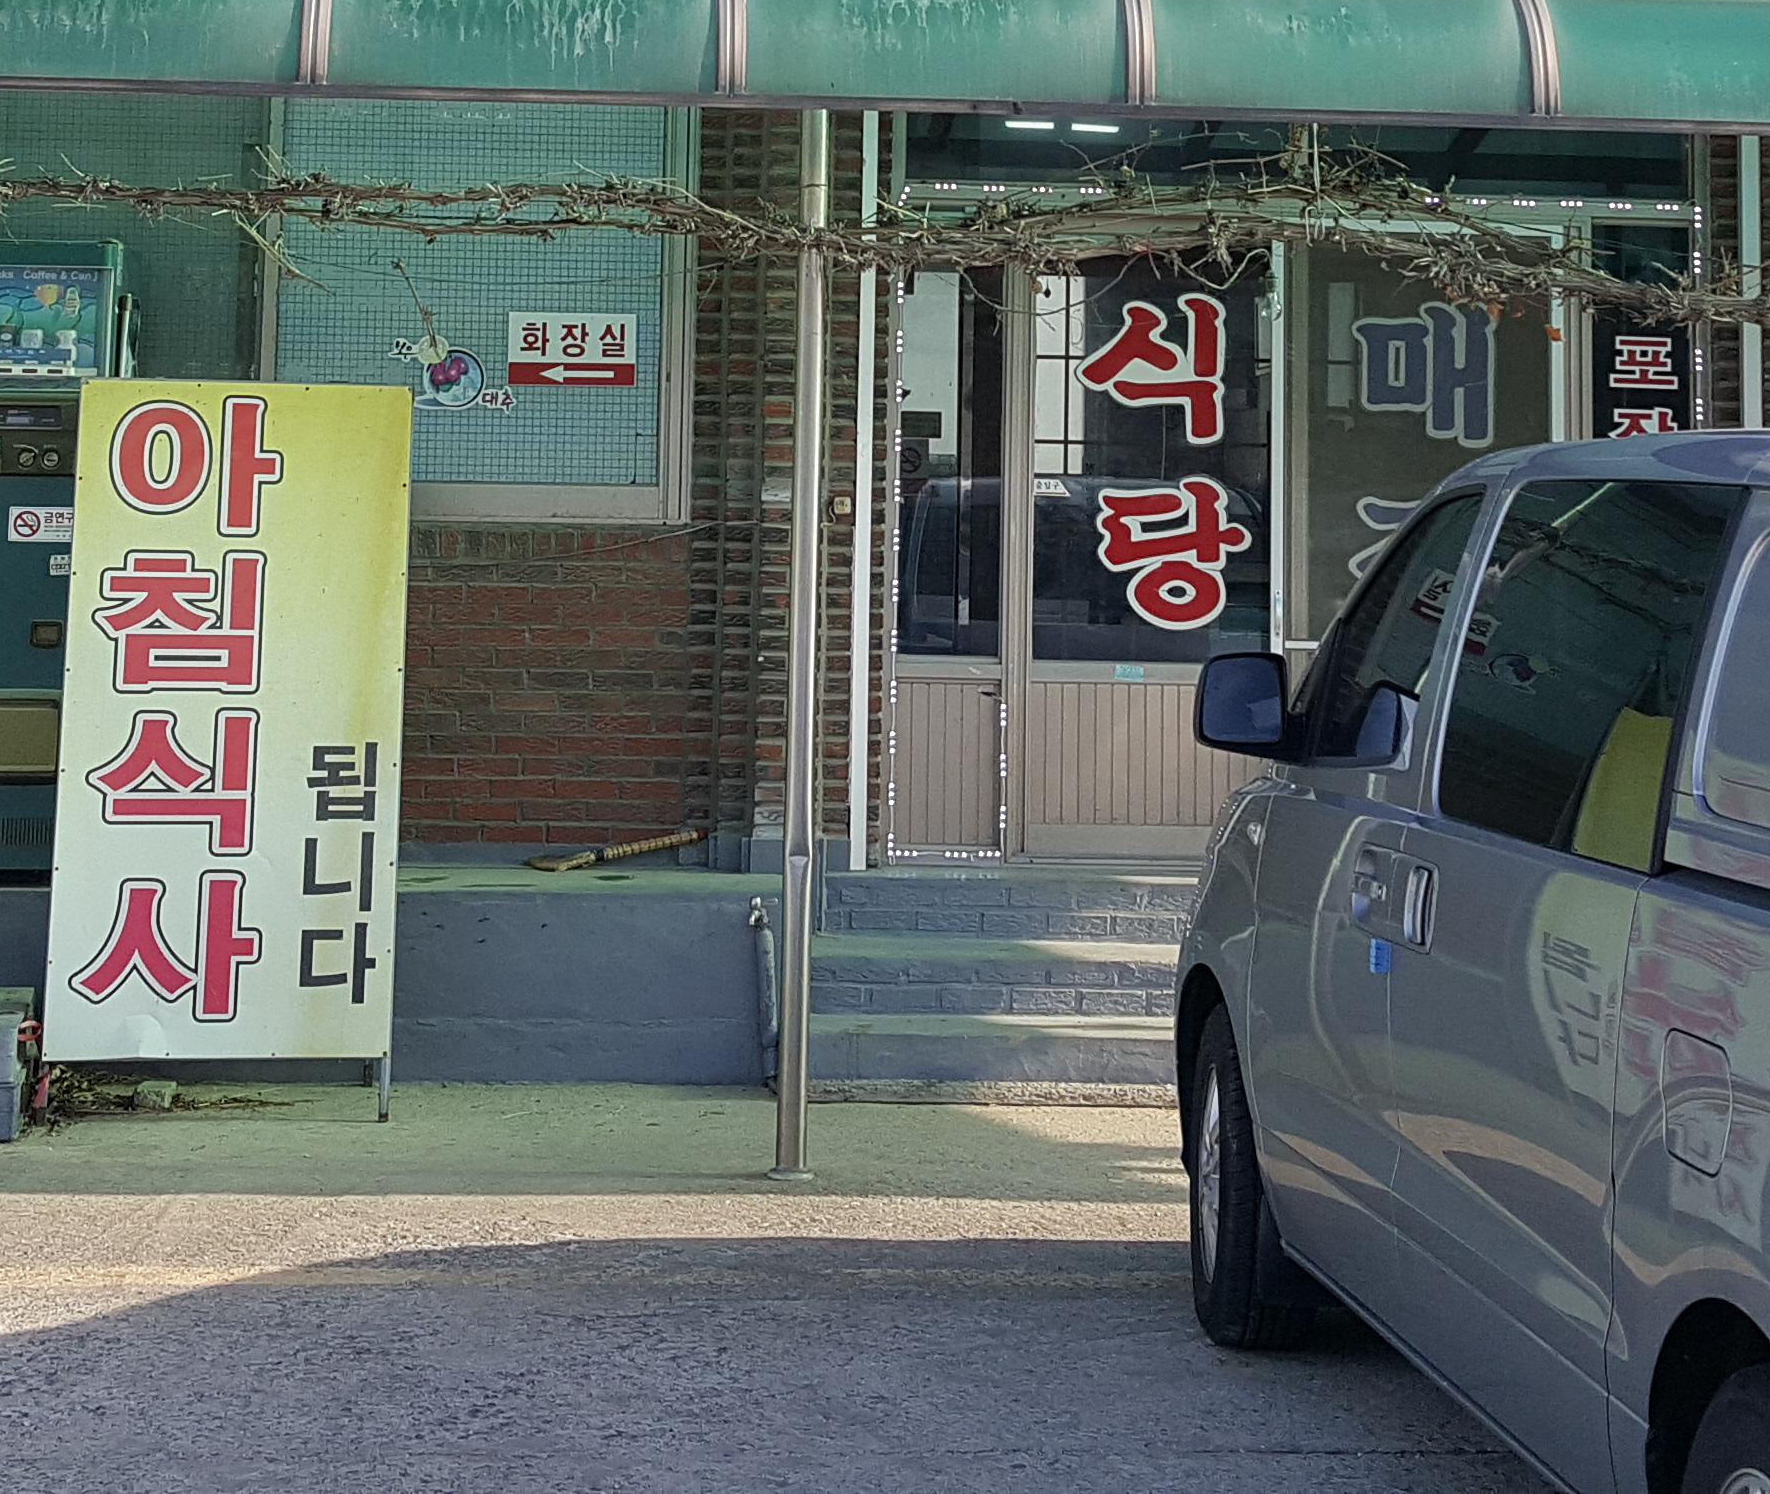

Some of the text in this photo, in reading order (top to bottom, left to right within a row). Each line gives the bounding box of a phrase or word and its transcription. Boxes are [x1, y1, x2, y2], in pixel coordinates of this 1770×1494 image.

[23, 270, 58, 280] Coffee
[519, 321, 627, 359] 화장실
[481, 387, 515, 412] 대추
[1076, 292, 1252, 629] 식당
[43, 511, 74, 524] 금연구
[69, 395, 283, 1022] 아침식사
[298, 741, 378, 1005] 됩니다
